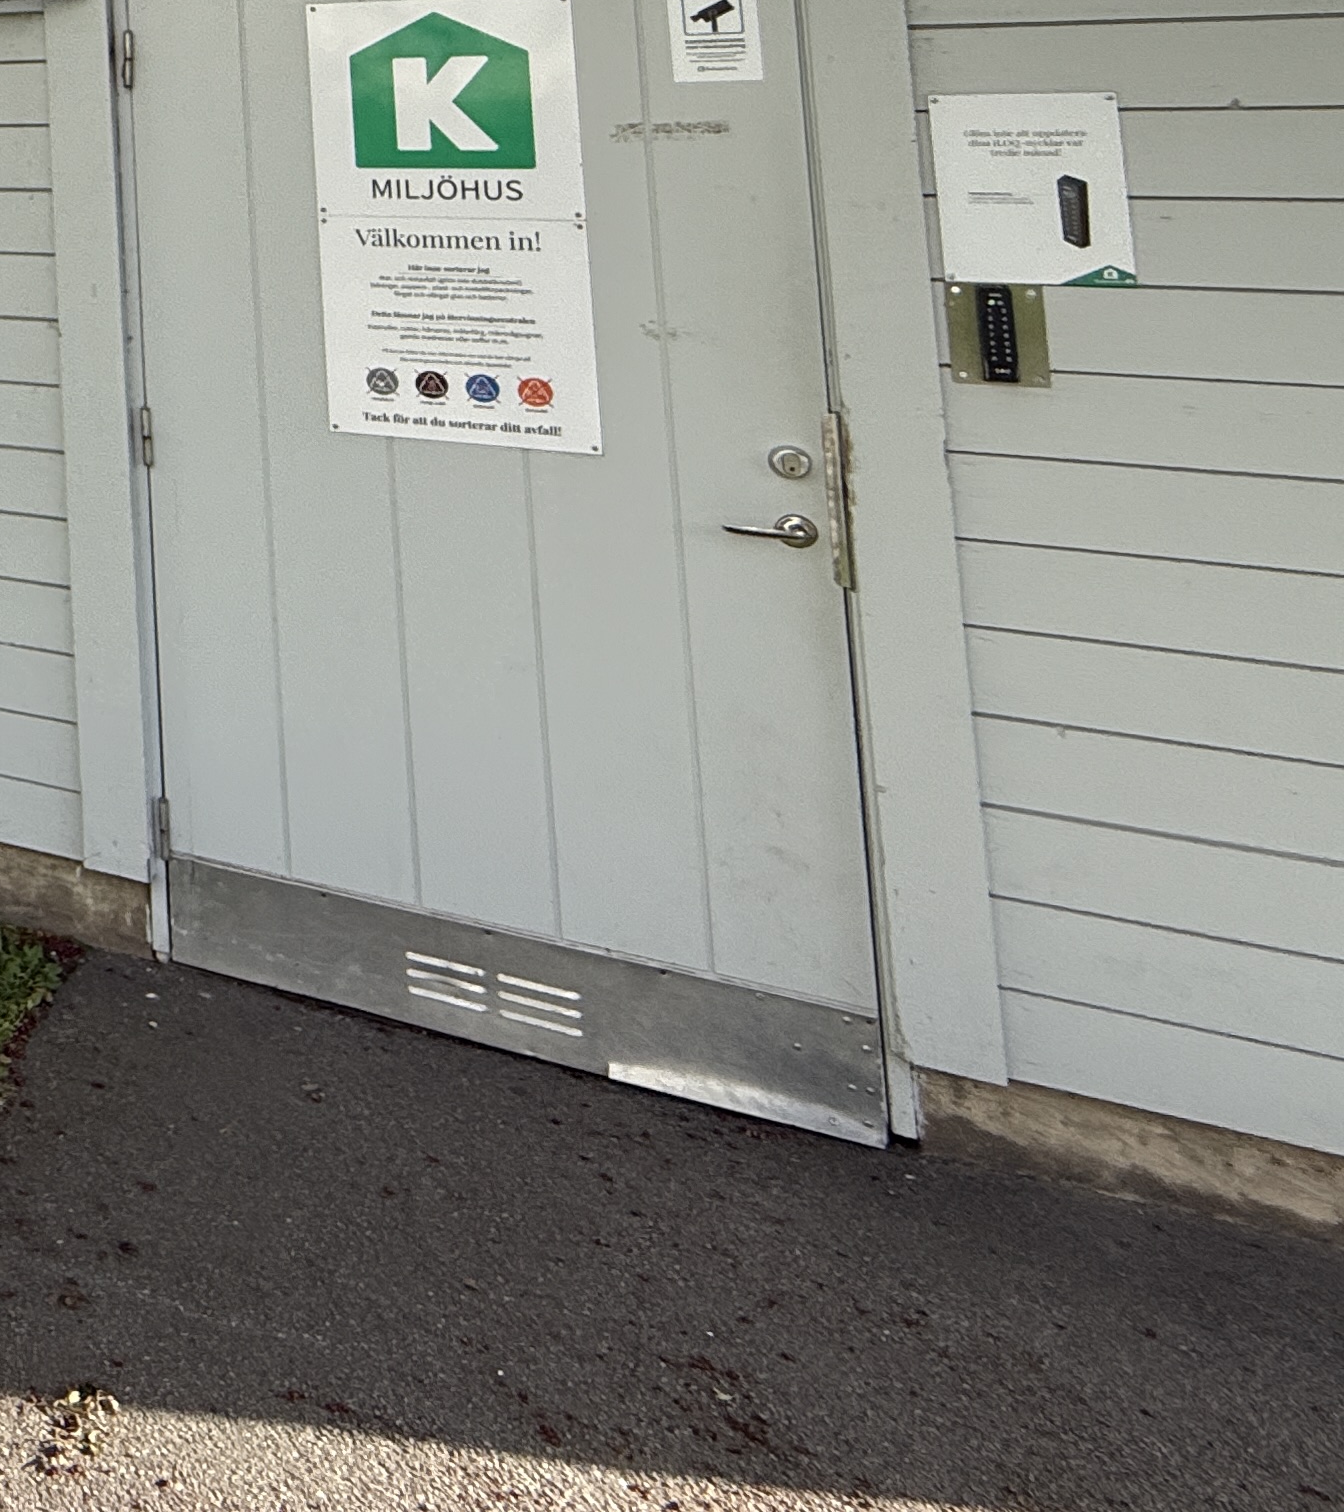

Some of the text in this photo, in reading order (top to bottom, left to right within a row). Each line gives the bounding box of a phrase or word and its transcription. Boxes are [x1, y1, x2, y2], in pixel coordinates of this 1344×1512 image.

[392, 55, 499, 151] K
[372, 175, 523, 201] MILJÖHUS
[355, 228, 542, 252] Välkommen in!
[362, 411, 562, 437] Tack för att du sorterar ditt avfall!
